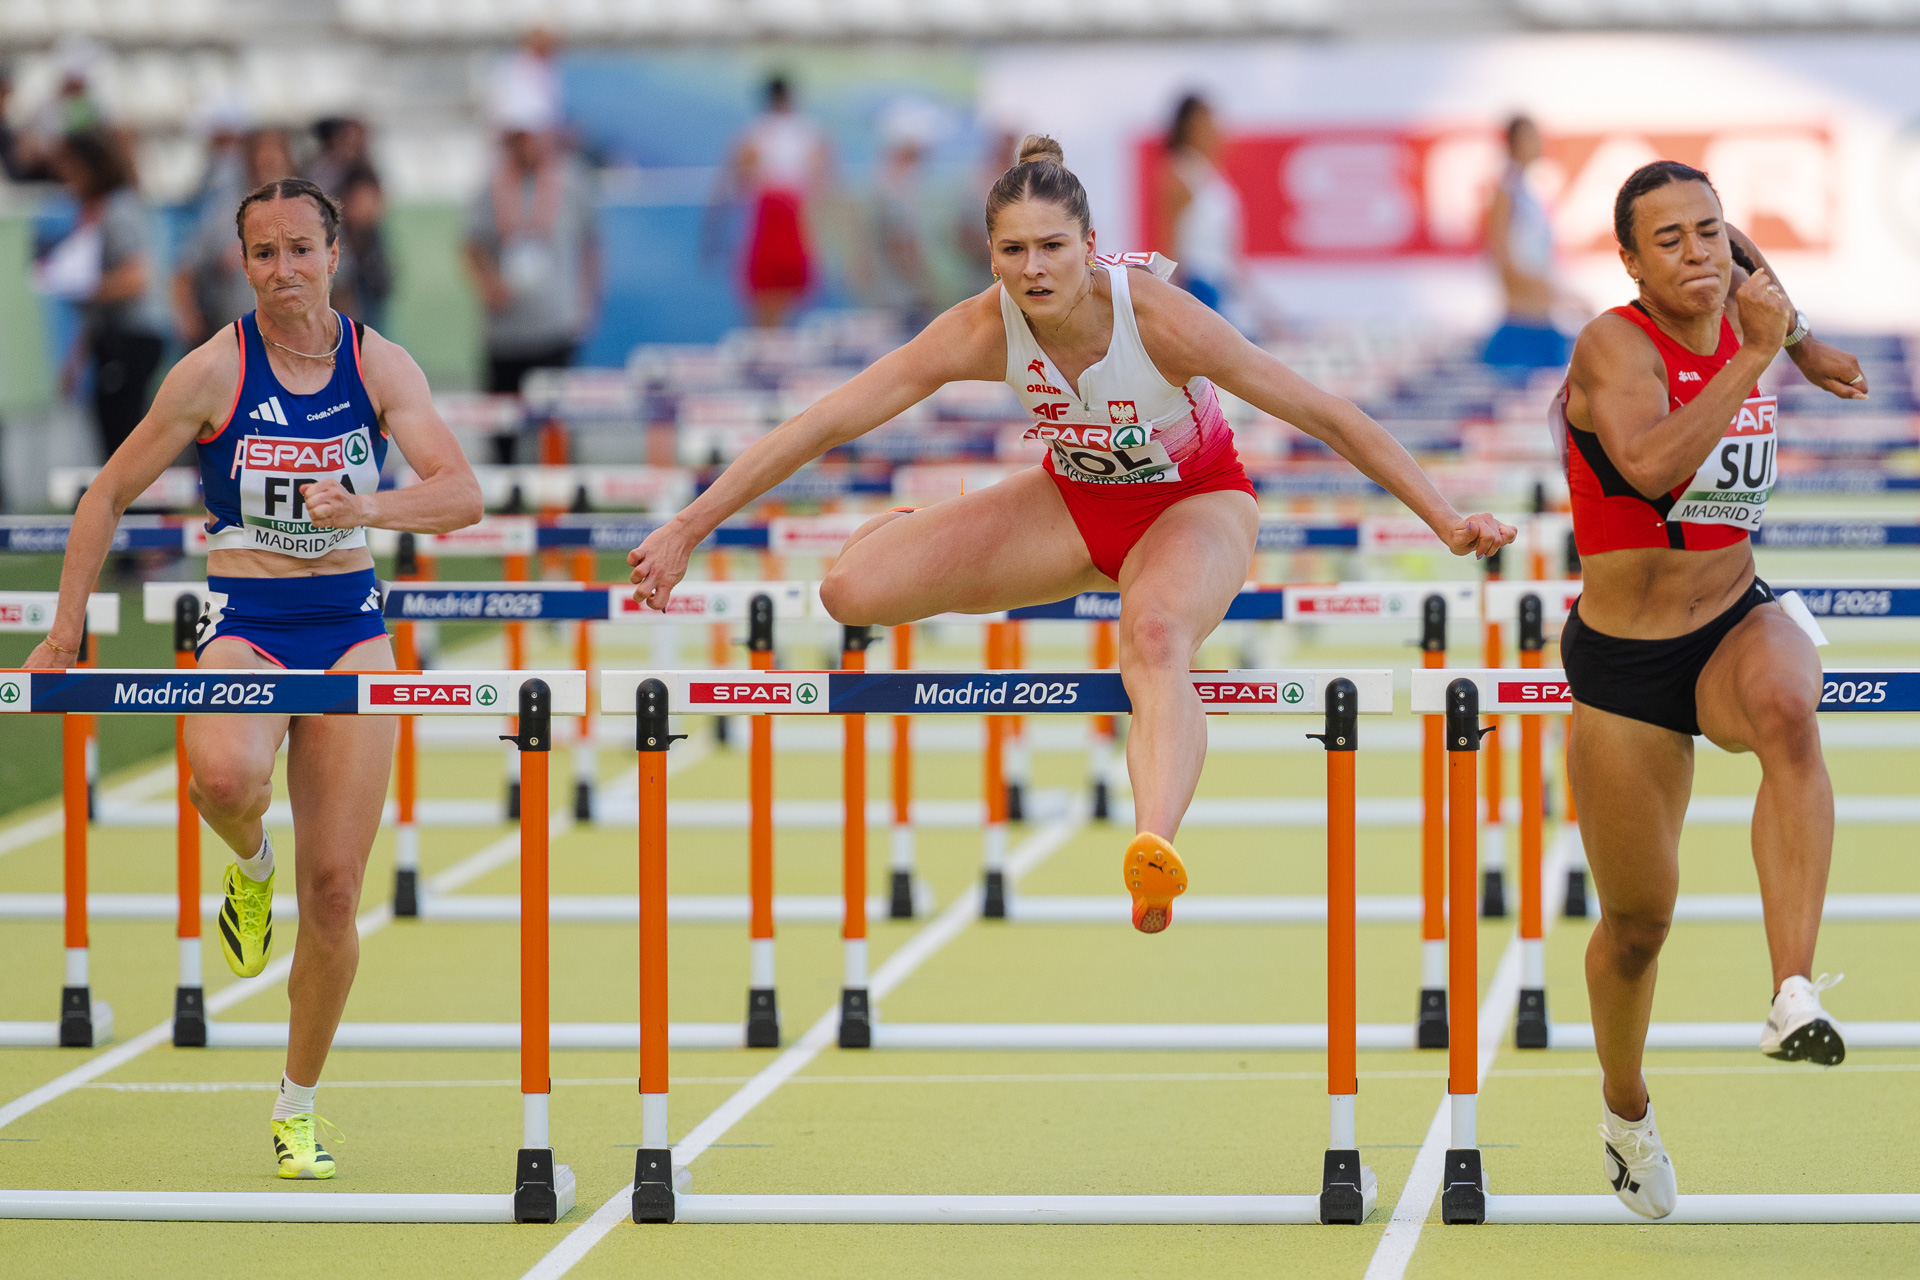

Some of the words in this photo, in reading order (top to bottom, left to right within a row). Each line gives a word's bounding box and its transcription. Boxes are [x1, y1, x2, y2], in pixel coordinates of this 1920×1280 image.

[1026, 384, 1062, 395] ORLEN
[1730, 405, 1775, 432] AR
[248, 443, 343, 468] SPAR
[1716, 438, 1775, 490] SUI
[1712, 492, 1738, 501] RUN
[1681, 504, 1750, 521] MADRID
[270, 521, 276, 529] I
[277, 521, 306, 534] RUN
[255, 528, 327, 553] MADRID
[402, 591, 483, 616] Madrid
[484, 592, 543, 617] 2025
[114, 681, 205, 704] Madrid
[210, 683, 276, 705] 2025
[393, 687, 470, 702] SPAR
[713, 686, 790, 700] SPAR
[915, 681, 1007, 704] Madrid
[1012, 682, 1079, 704] 2025
[1199, 685, 1276, 700] SPAR
[1821, 681, 1888, 703] 2025
